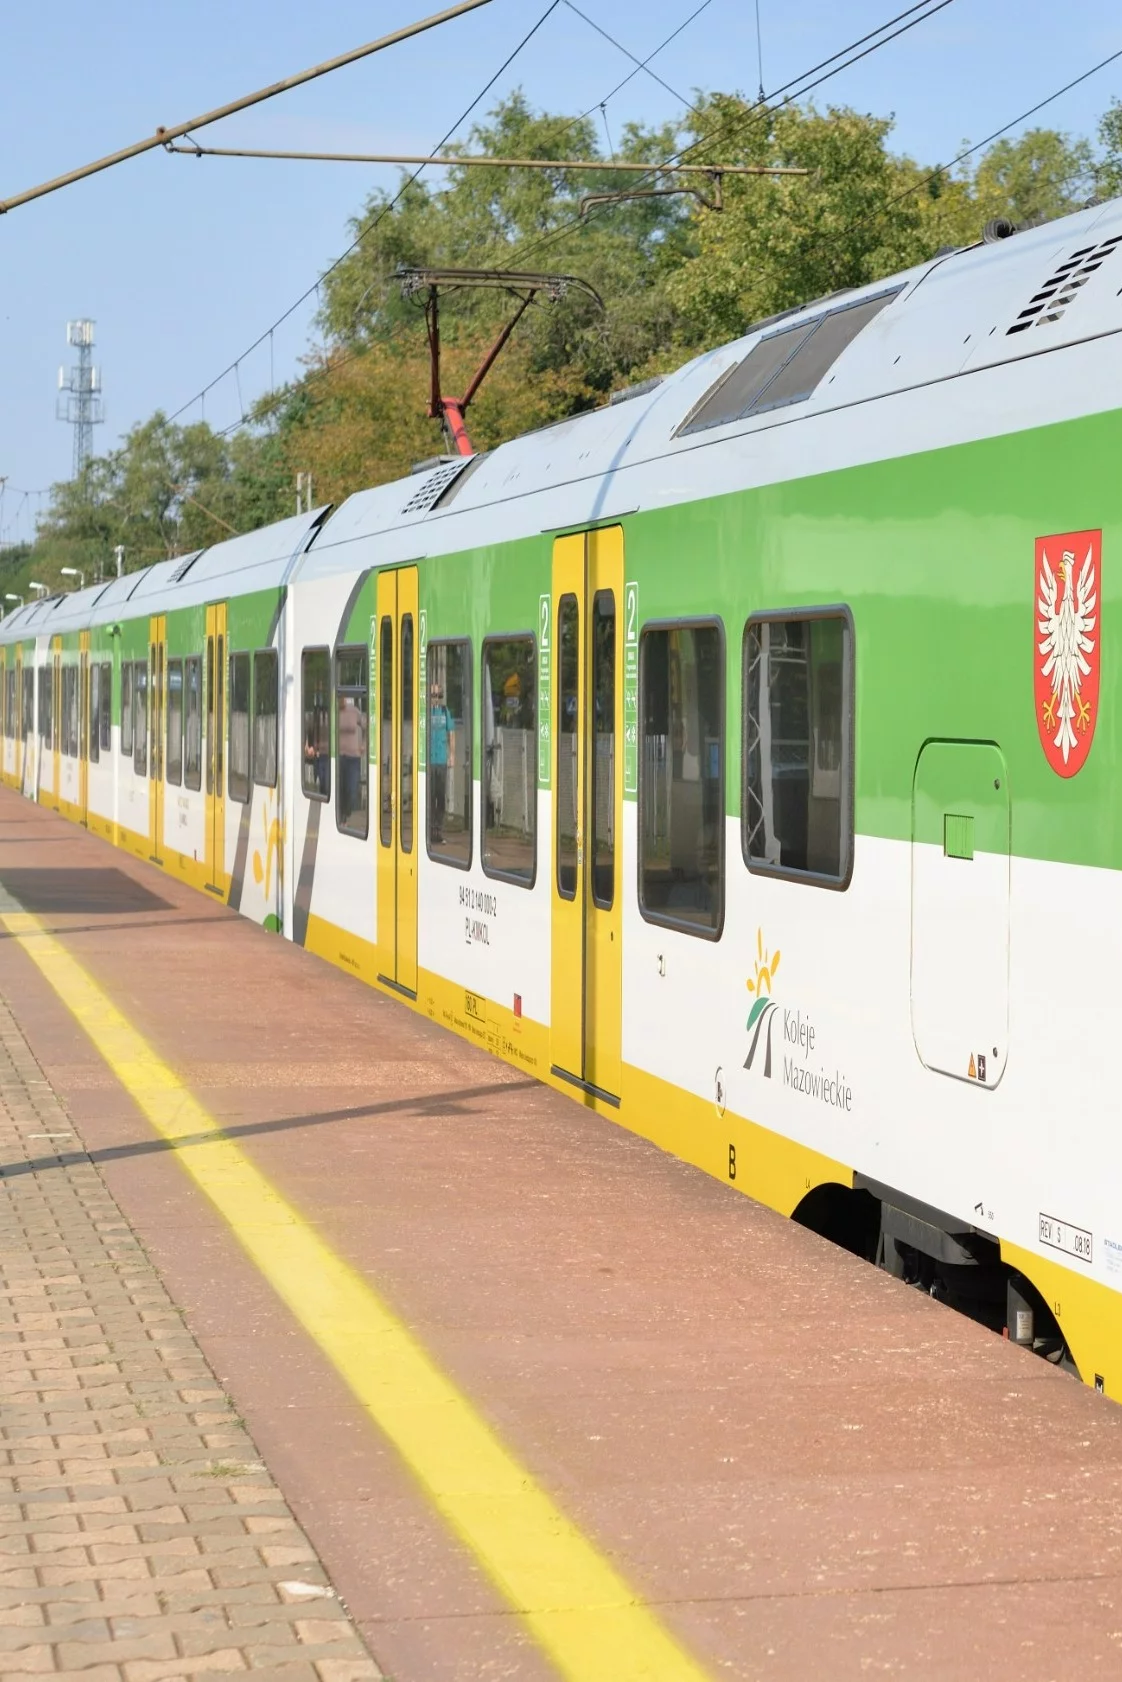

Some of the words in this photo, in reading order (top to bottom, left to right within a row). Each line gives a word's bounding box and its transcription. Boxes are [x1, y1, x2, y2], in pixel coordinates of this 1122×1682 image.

[541, 600, 549, 647] 2
[627, 588, 636, 641] 2
[783, 1008, 816, 1060] Koleje
[782, 1056, 853, 1113] Mazowieckie
[728, 1144, 737, 1181] B
[1041, 1221, 1052, 1239] REV
